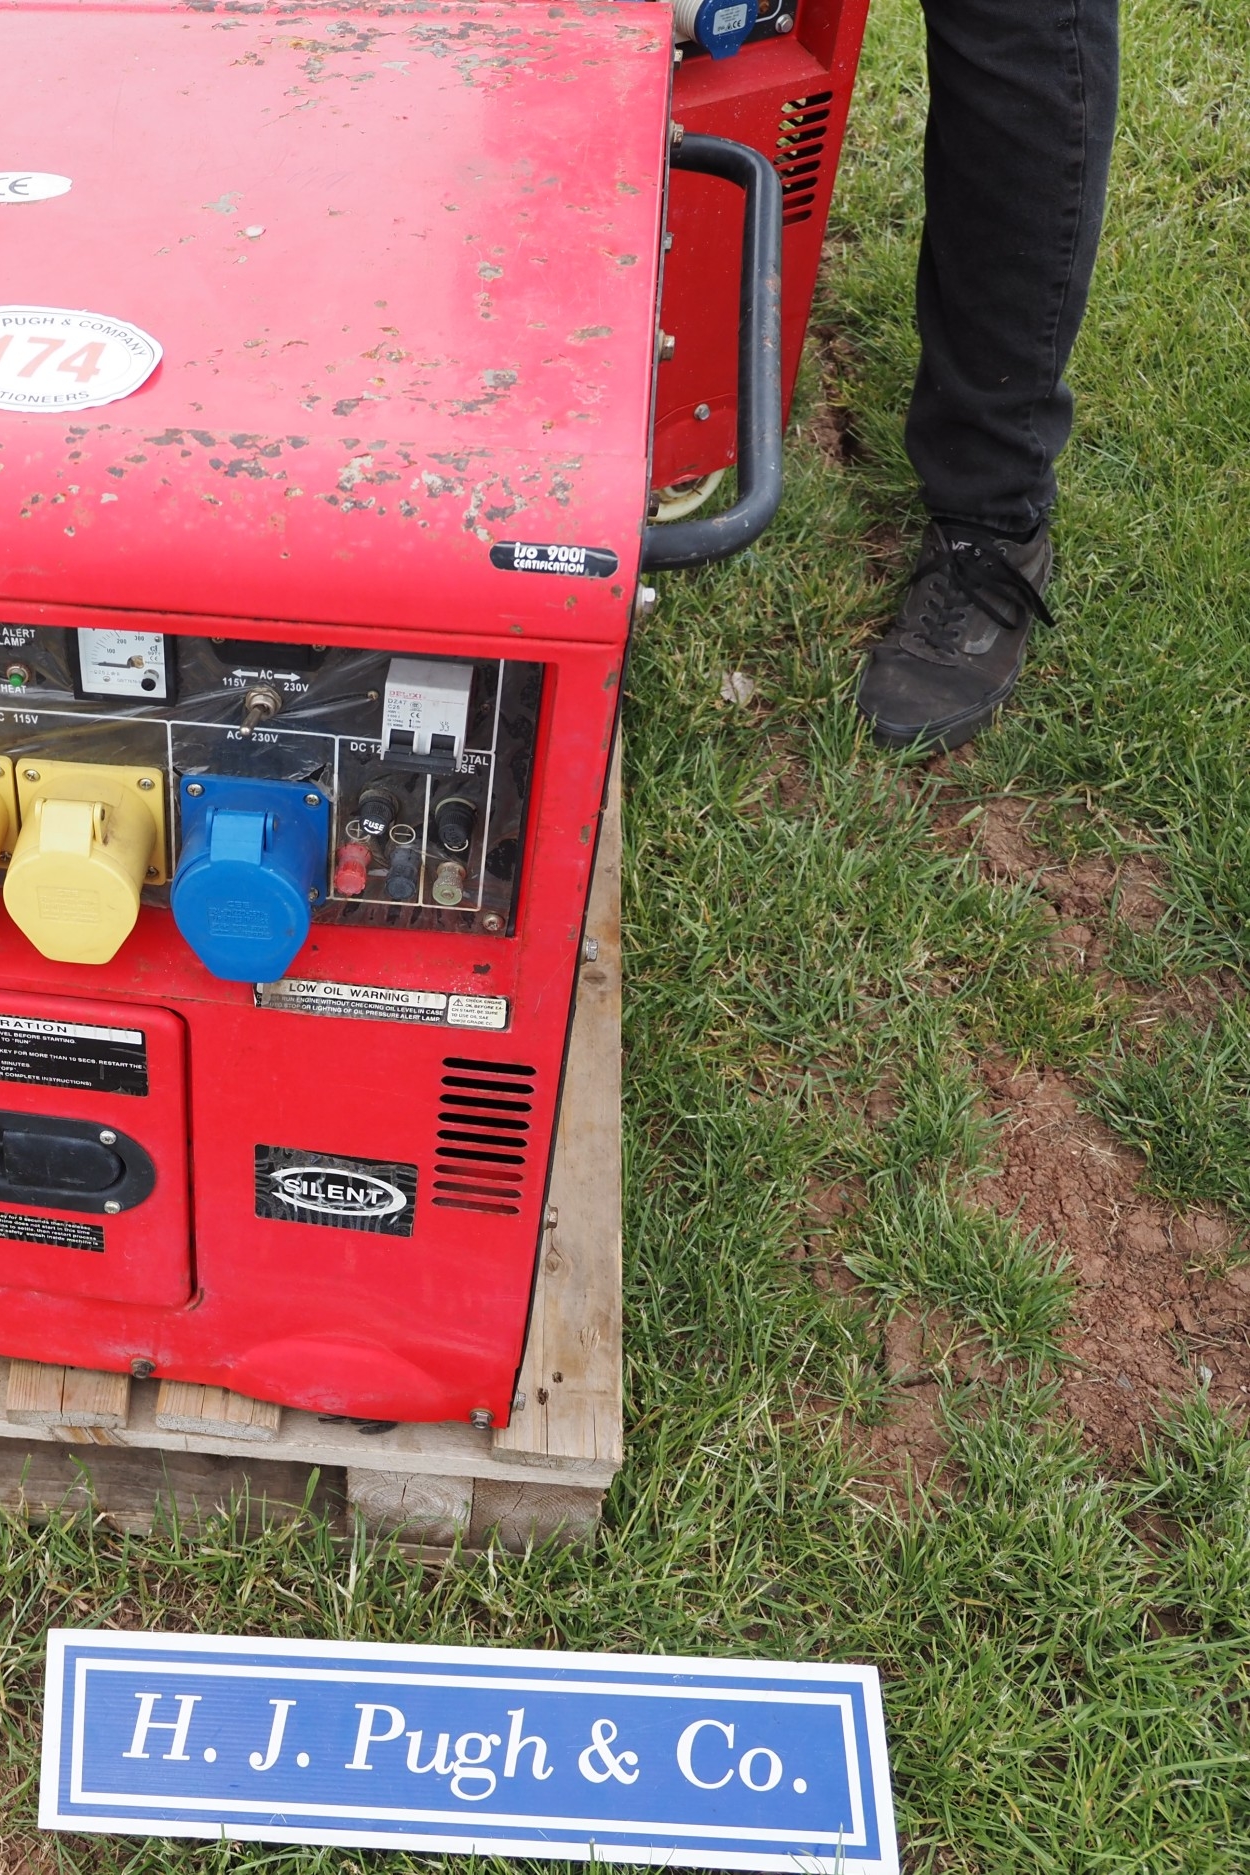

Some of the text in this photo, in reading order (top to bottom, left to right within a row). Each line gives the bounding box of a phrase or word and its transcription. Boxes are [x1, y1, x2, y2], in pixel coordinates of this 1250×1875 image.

[2, 317, 54, 328] PUGH
[61, 318, 71, 326] &
[78, 320, 148, 357] COMPANY
[951, 540, 981, 556] VAS
[514, 559, 584, 573] CERTIFICATION
[2, 628, 36, 637] ALERT
[260, 670, 272, 679] AC
[222, 678, 246, 687] 115V
[284, 682, 309, 692] 230V
[0, 684, 26, 693] HEAT
[14, 714, 38, 724] 115V
[226, 731, 278, 743] AC 230V
[350, 742, 382, 754] DC 12
[461, 755, 489, 765] OTAL
[455, 765, 475, 774] SE
[363, 819, 385, 830] FUSE
[290, 984, 317, 993] LOW
[324, 987, 343, 995] OIL
[350, 989, 410, 1002] WARNING
[351, 1002, 384, 1010] CHECKING
[366, 1010, 400, 1018] PRESSURE
[5, 1072, 40, 1080] COMPLETE
[284, 1179, 384, 1204] SILENT
[122, 1693, 808, 1801] H. J. Pugh & Co.
